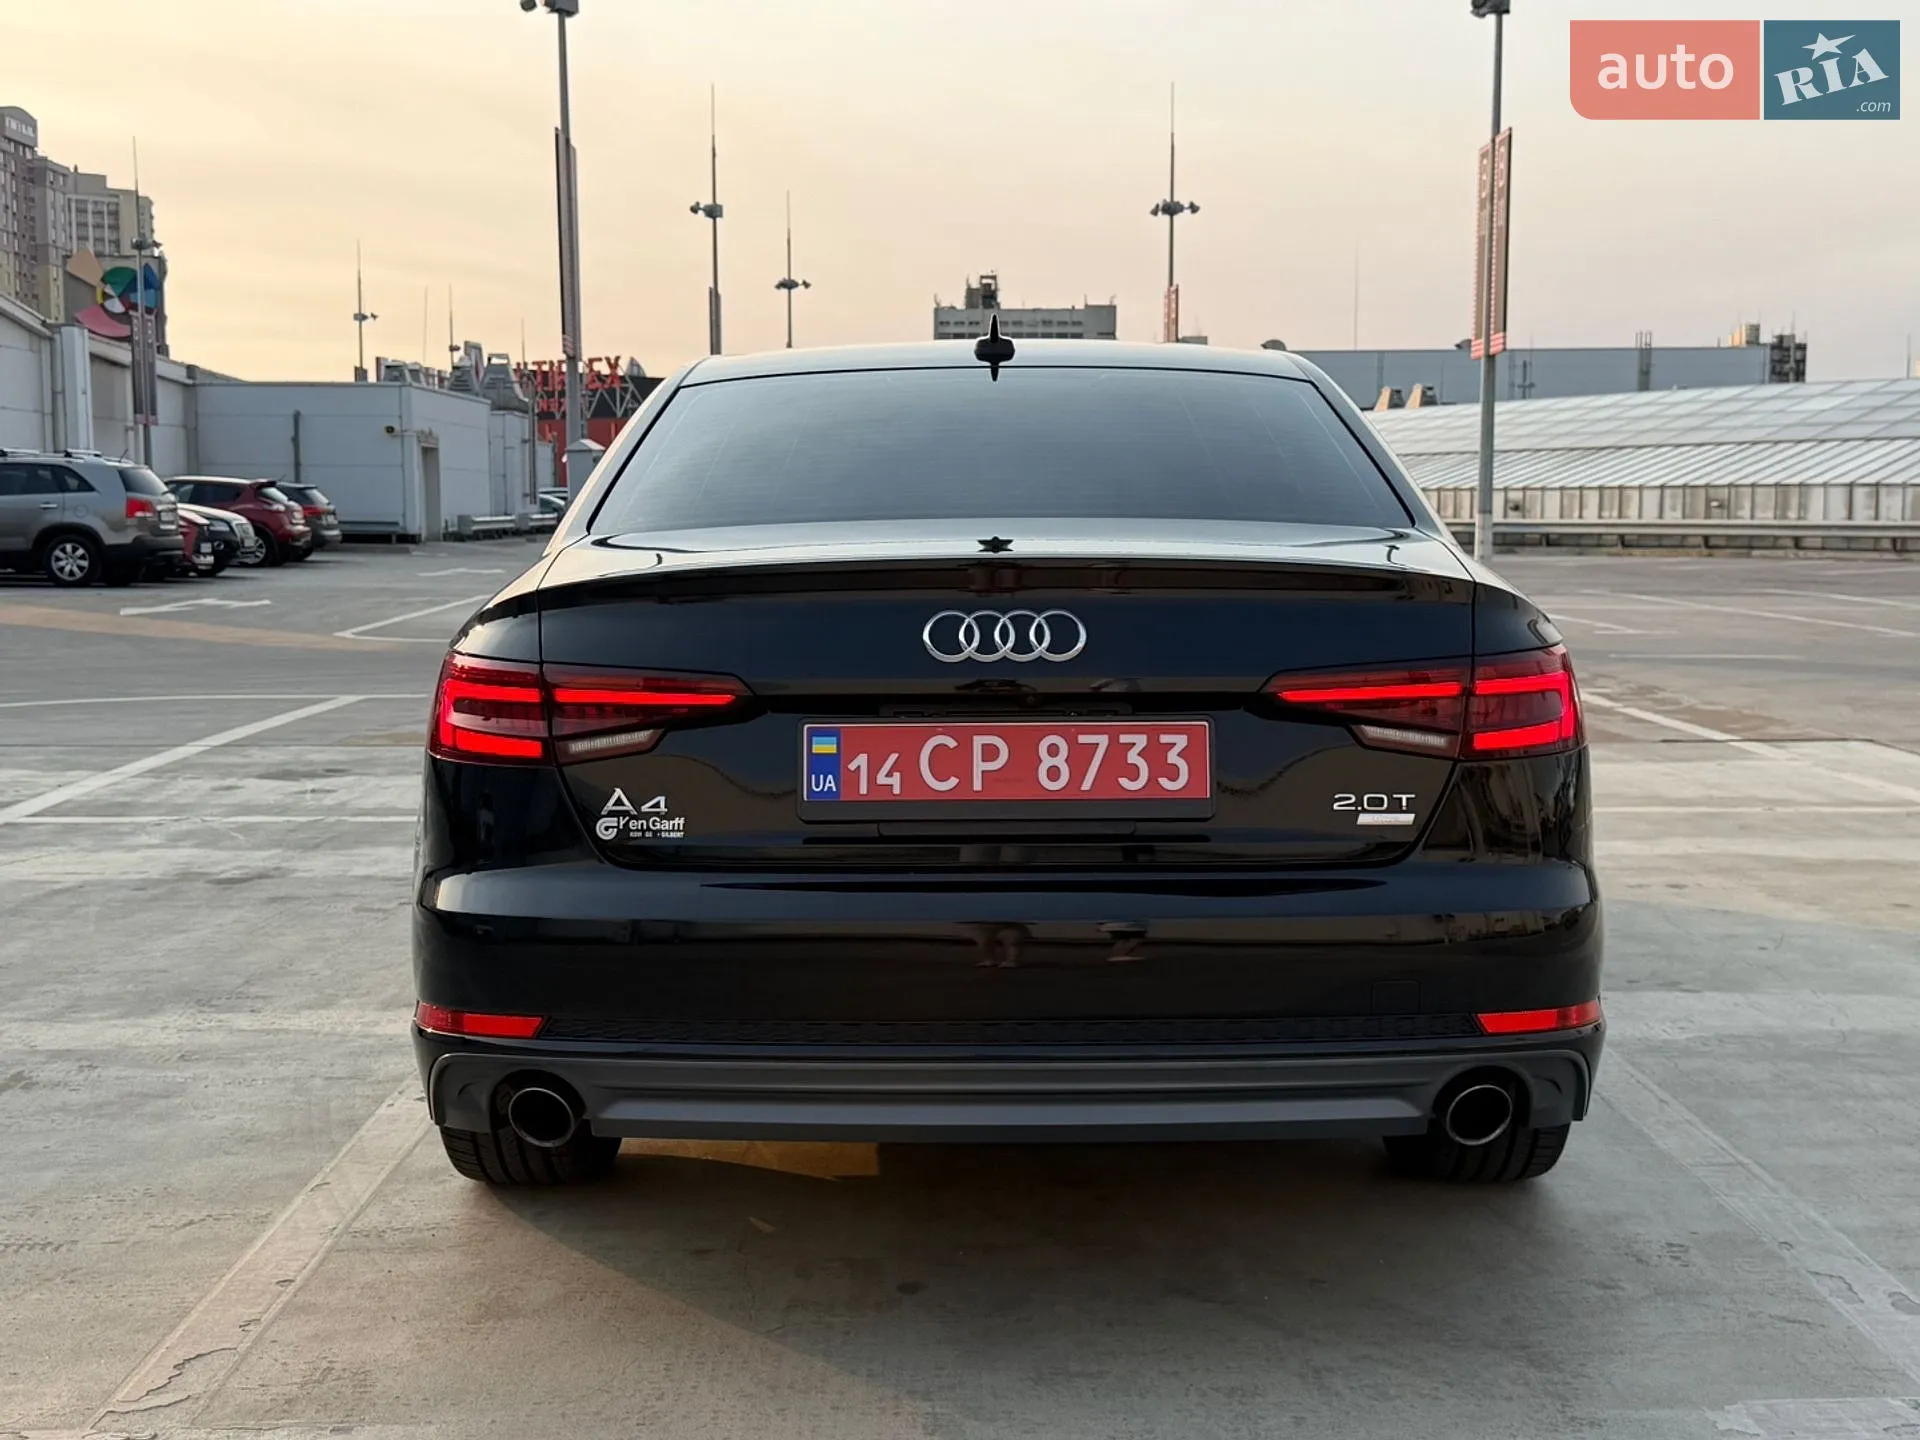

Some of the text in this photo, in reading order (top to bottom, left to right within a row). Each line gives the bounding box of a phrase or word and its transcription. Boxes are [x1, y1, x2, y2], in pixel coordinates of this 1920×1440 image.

[847, 733, 1190, 796] 14 CP 8733
[811, 774, 837, 792] UA
[600, 787, 668, 815] A4
[1333, 793, 1416, 811] 2.0T
[648, 816, 686, 831] Garff
